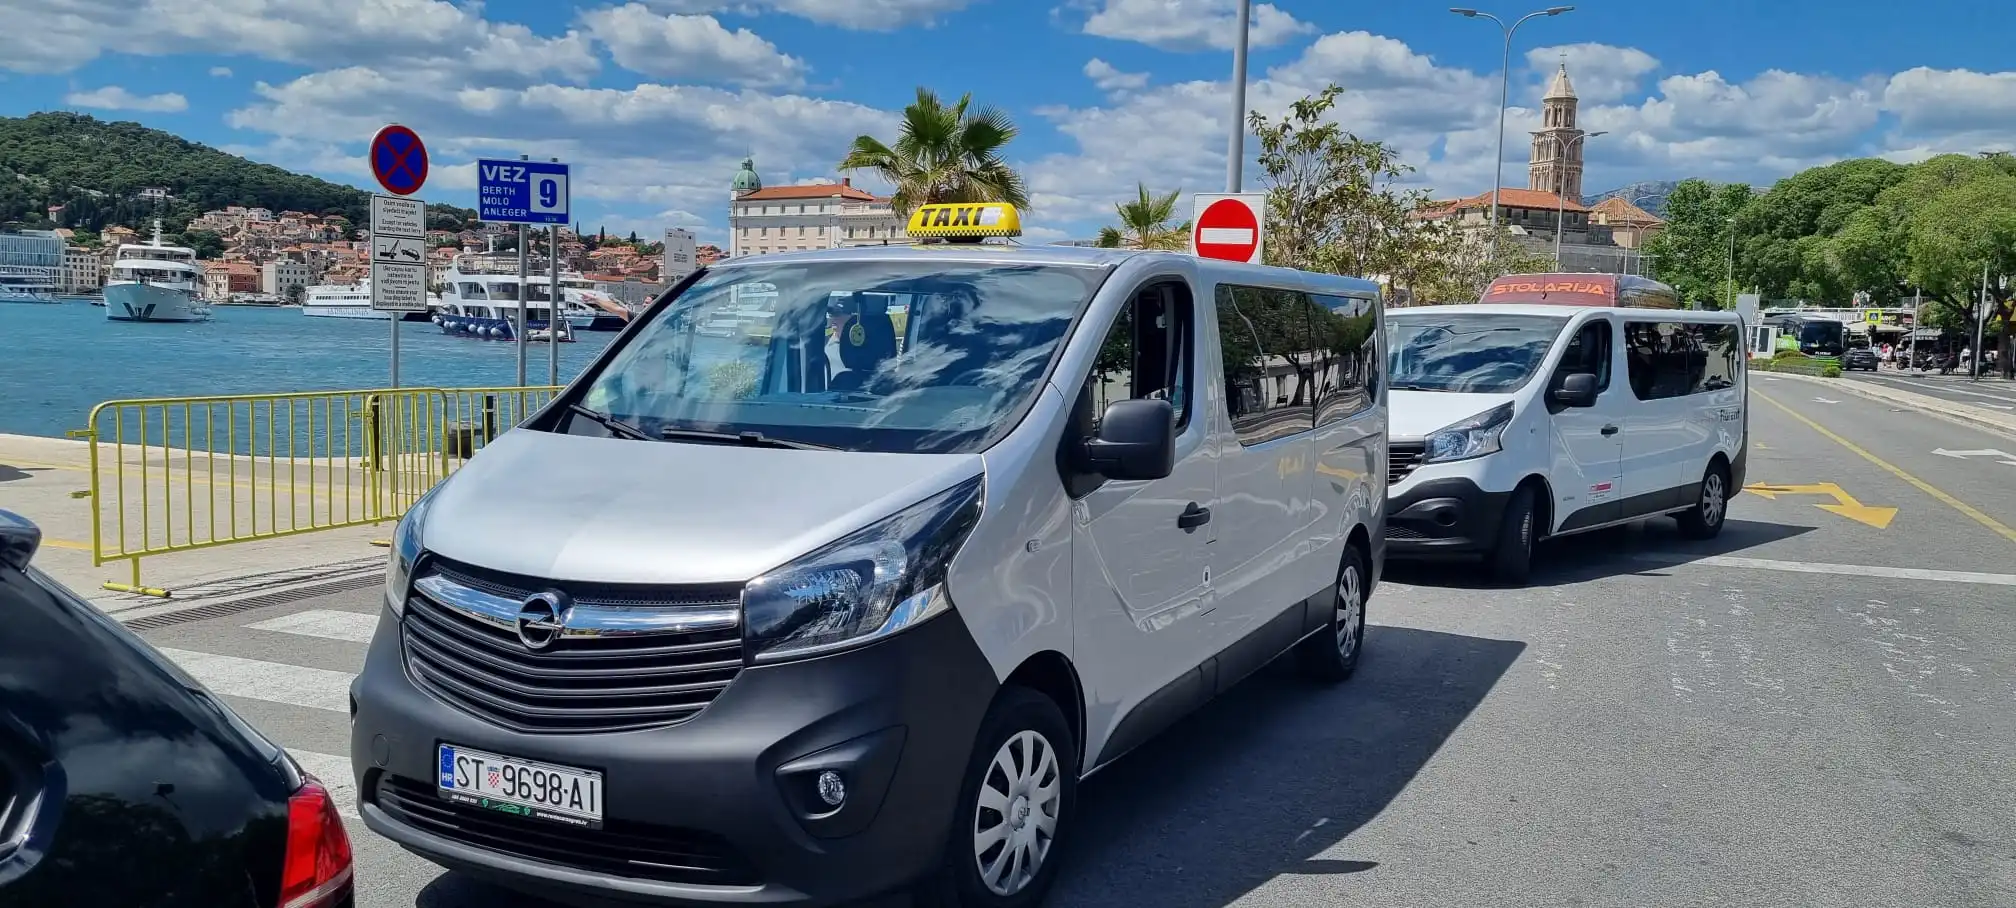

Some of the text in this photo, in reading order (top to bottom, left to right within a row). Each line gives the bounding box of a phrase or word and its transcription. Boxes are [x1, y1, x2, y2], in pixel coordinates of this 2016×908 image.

[482, 165, 526, 183] VEZ
[482, 185, 516, 196] BERTH
[540, 179, 557, 208] 9
[483, 197, 510, 206] MOLO
[483, 207, 527, 217] ANLEGER
[920, 207, 984, 227] TAXI
[1492, 282, 1605, 295] STOLARIJA
[442, 772, 454, 783] HR
[456, 755, 484, 791] ST
